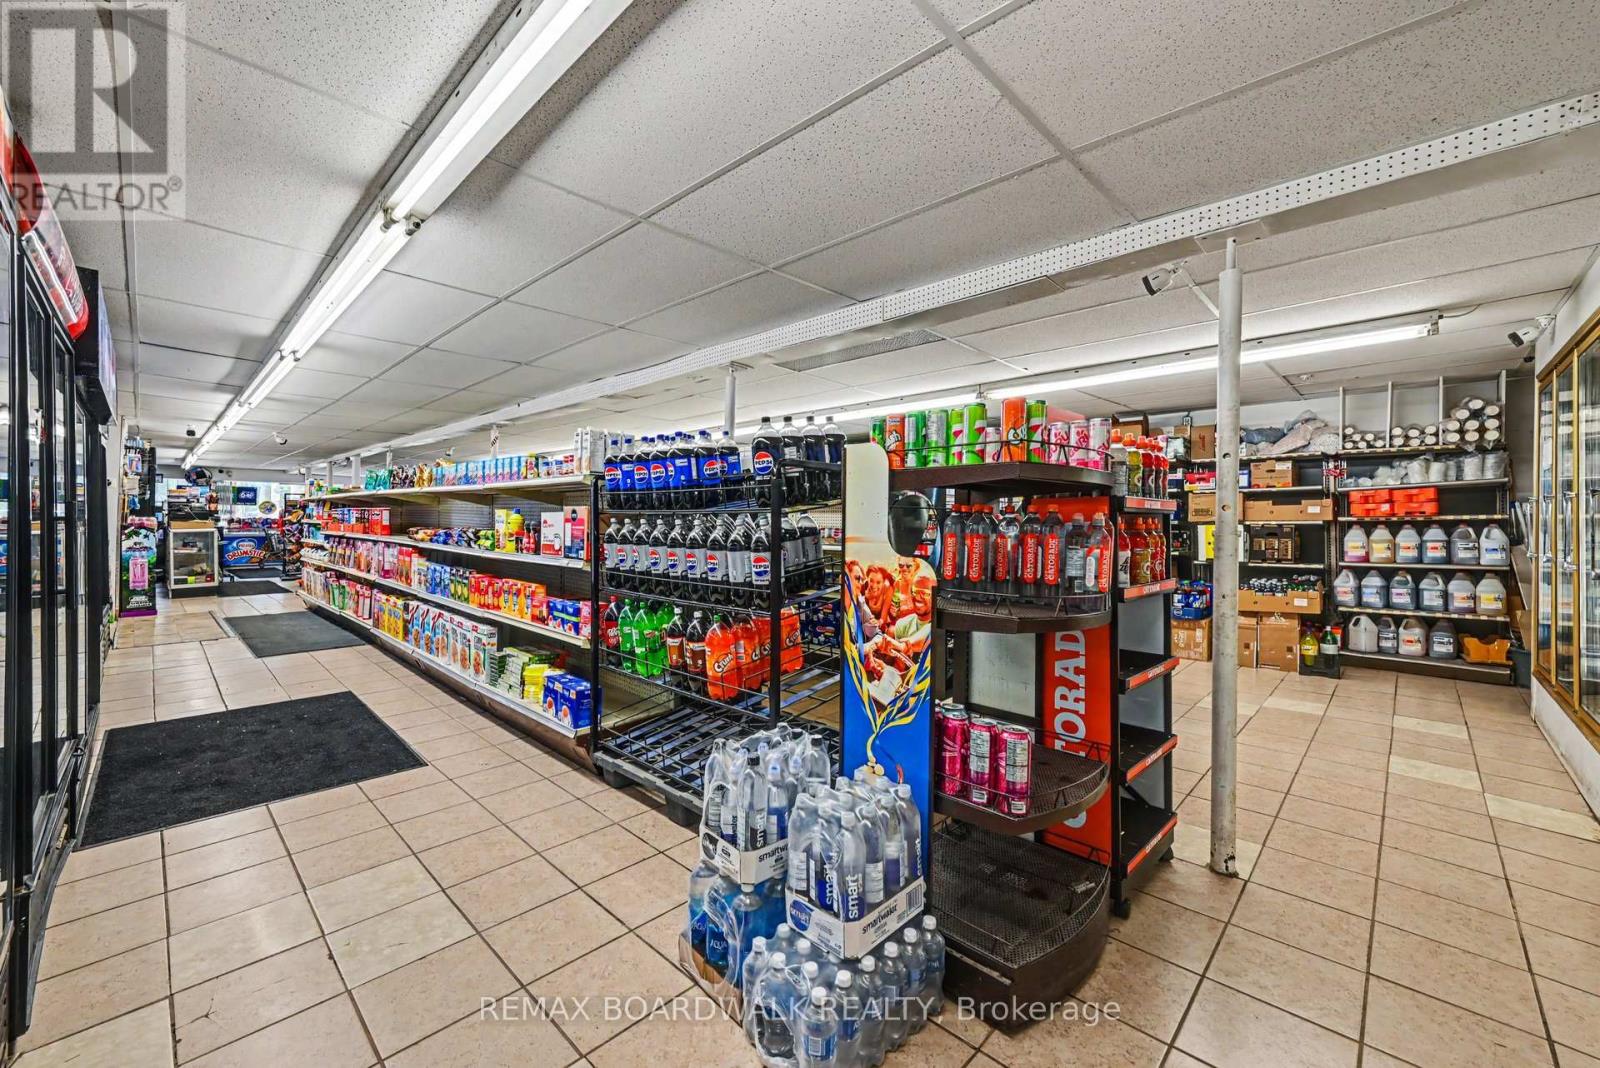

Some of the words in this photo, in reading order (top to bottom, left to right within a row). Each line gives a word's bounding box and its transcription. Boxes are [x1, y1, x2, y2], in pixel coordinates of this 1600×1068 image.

[225, 549, 265, 561] DRUMSTIC
[971, 537, 980, 578] GATORADE
[1047, 538, 1056, 580] GATORADE
[758, 843, 789, 863] smartw
[845, 873, 859, 919] smart
